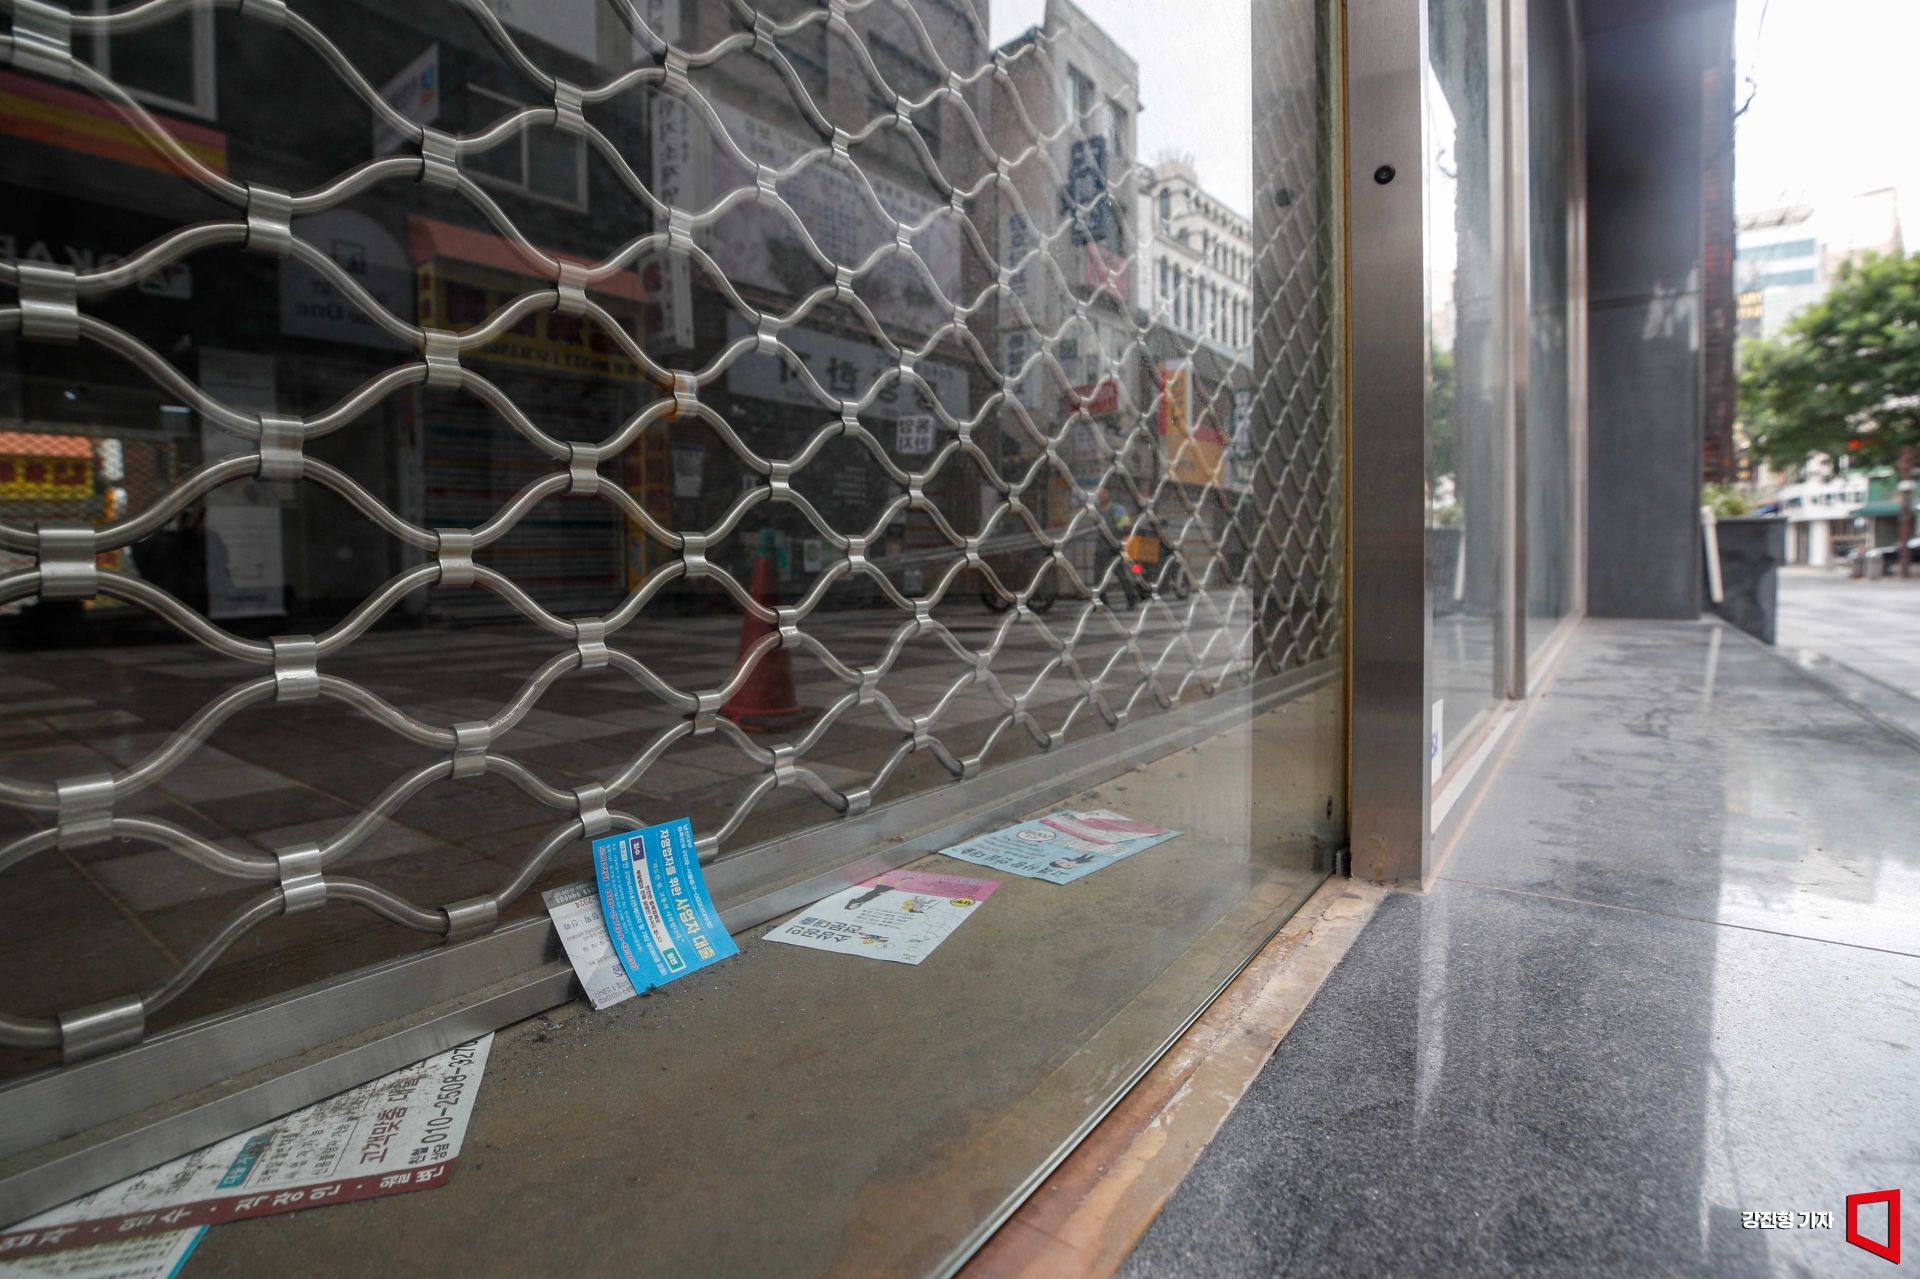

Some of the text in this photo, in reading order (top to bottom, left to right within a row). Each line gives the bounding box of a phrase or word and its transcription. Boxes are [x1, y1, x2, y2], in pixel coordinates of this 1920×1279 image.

[657, 828, 676, 876] 자영업자를
[668, 876, 682, 897] 위한
[674, 896, 700, 934] 사업자
[798, 915, 864, 935] 전문대출
[785, 925, 852, 943] 소상공인
[360, 1106, 408, 1165] 고객맞춤
[430, 1143, 450, 1161] 상담
[235, 1182, 343, 1213] 직장인
[379, 1164, 445, 1189] 월변
